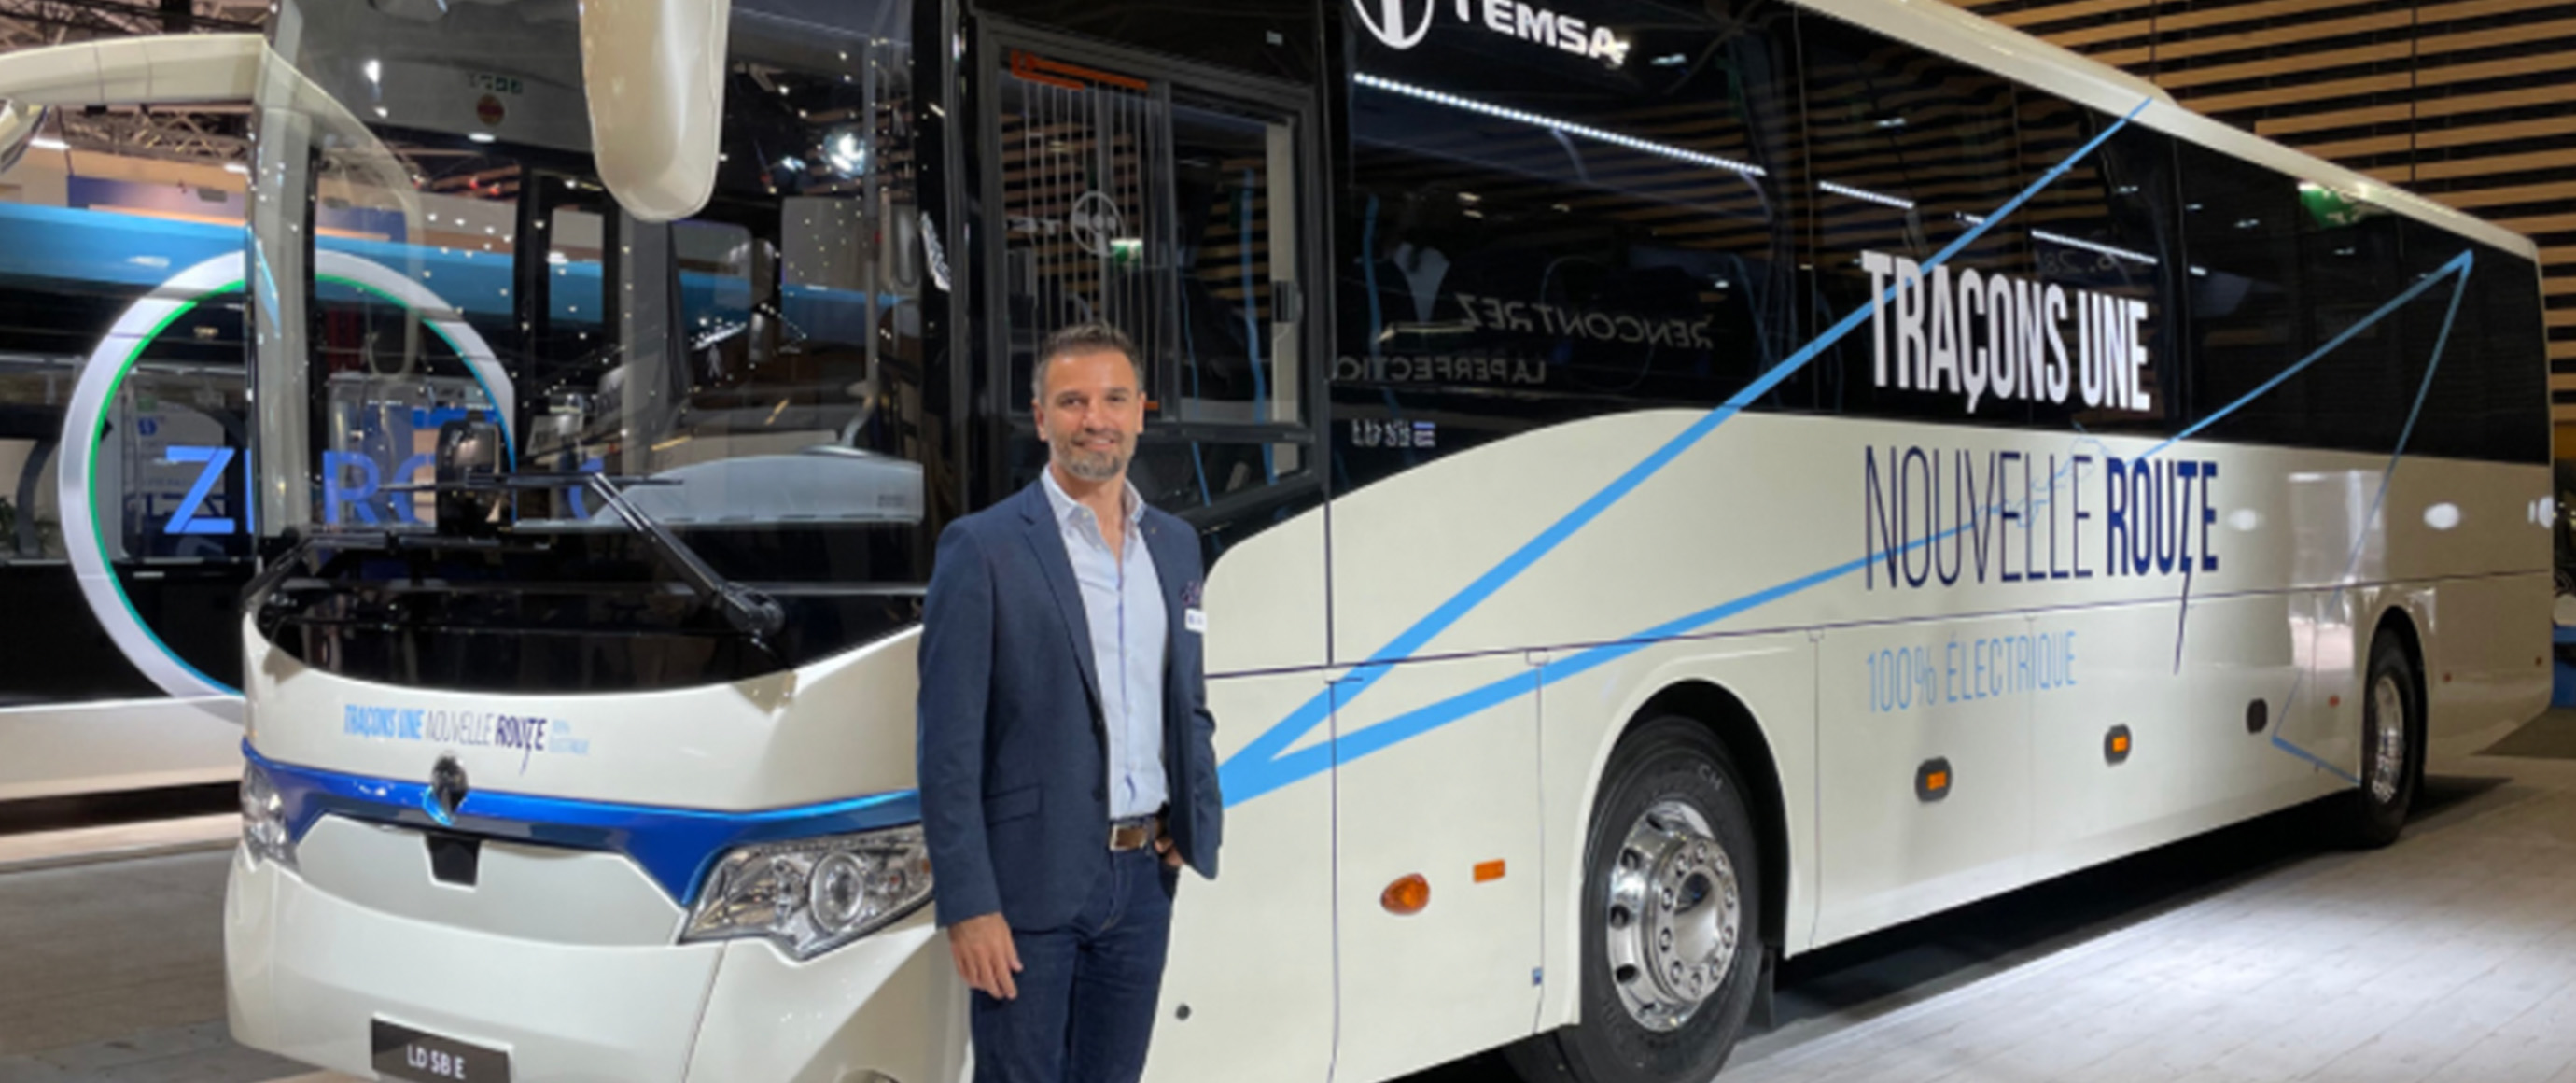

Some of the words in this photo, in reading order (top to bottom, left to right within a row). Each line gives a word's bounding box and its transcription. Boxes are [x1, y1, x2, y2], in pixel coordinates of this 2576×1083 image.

[1861, 250, 2070, 413] TRAÇONS
[2077, 290, 2150, 411] UNE
[163, 445, 439, 534] ZRO
[1866, 445, 2093, 591] NOUVELLE
[2106, 457, 2219, 671] ROUTE
[1868, 646, 1938, 713] 100%
[1947, 630, 2078, 705] ÉLECTRIQUE
[344, 704, 396, 738] TRAÇONS
[426, 710, 495, 746] NOUVELLE
[496, 714, 547, 776] ROUTE
[407, 1043, 427, 1069] LD
[454, 1056, 466, 1079] E
